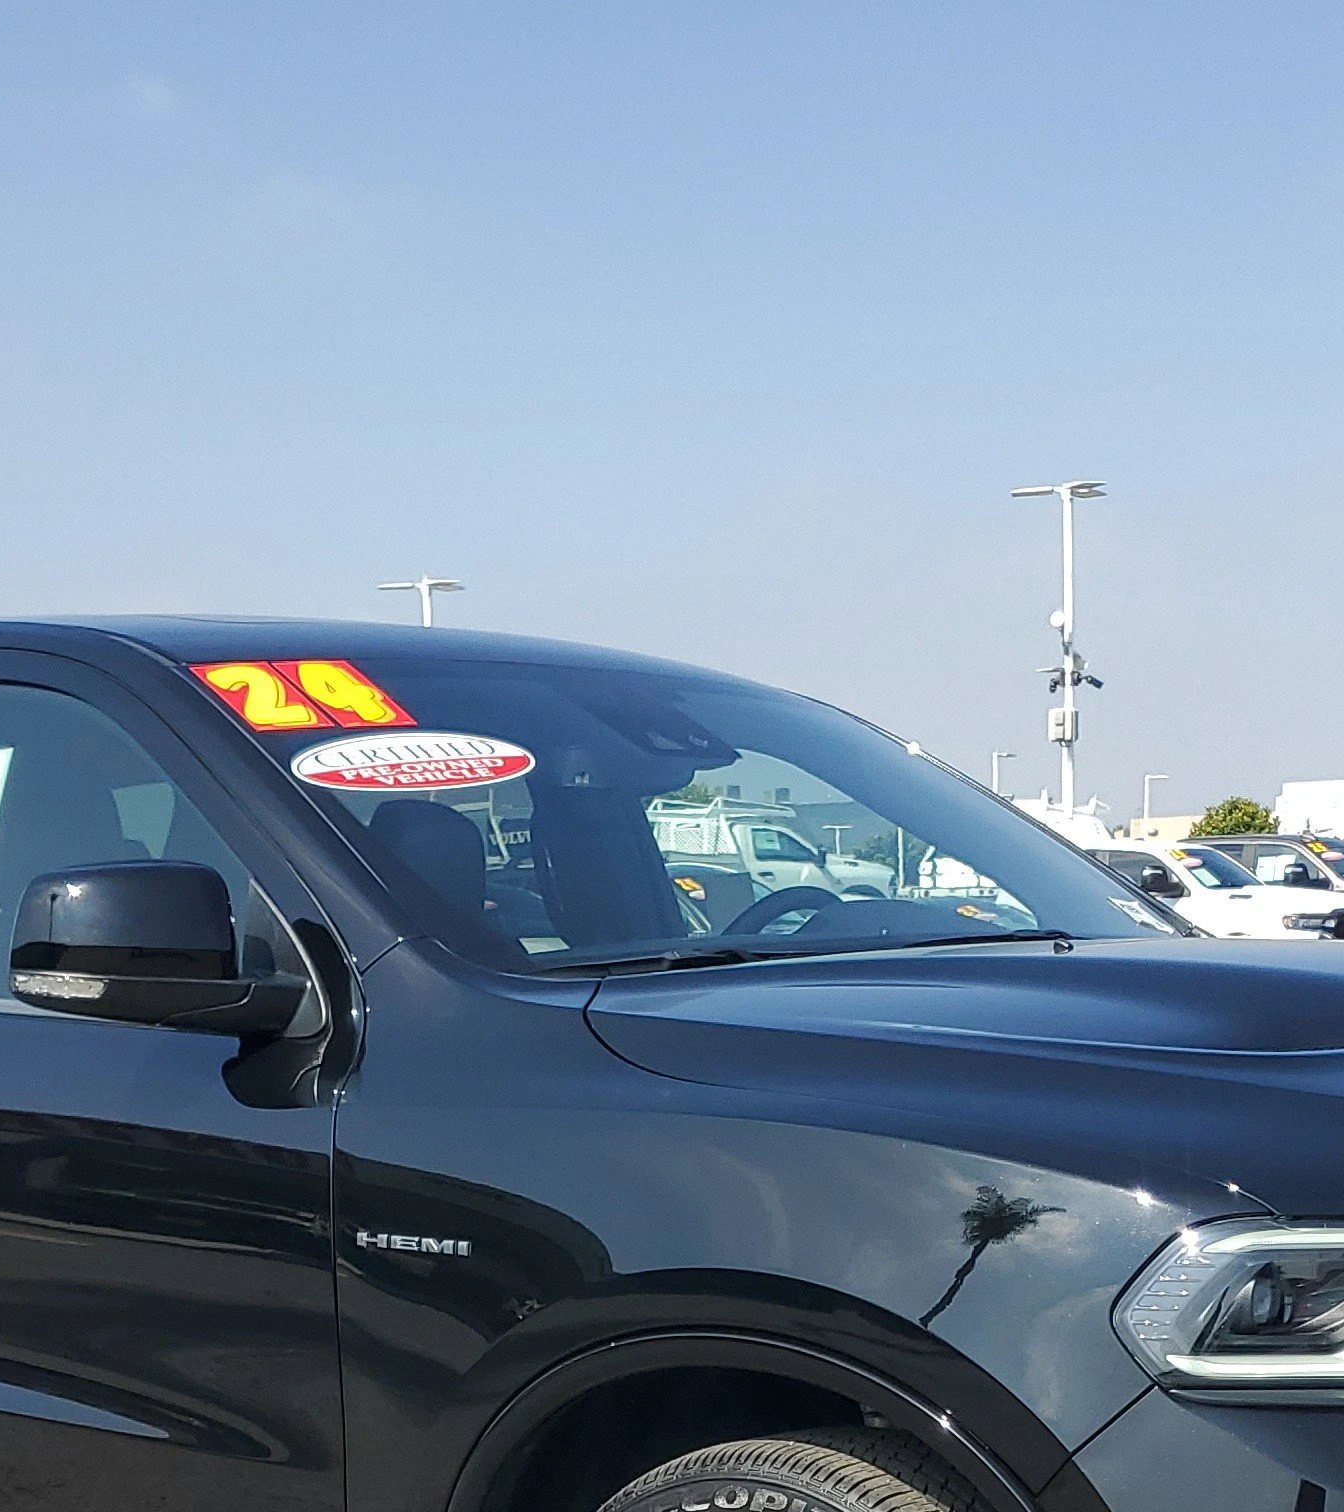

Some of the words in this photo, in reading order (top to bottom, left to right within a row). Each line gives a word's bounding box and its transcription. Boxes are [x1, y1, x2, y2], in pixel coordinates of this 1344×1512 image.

[205, 662, 398, 727] 24
[314, 739, 496, 768] CERTIFIED
[338, 757, 505, 783] PRE-OWNED
[373, 766, 496, 786] VEHICLE
[356, 1231, 472, 1257] HEMI
